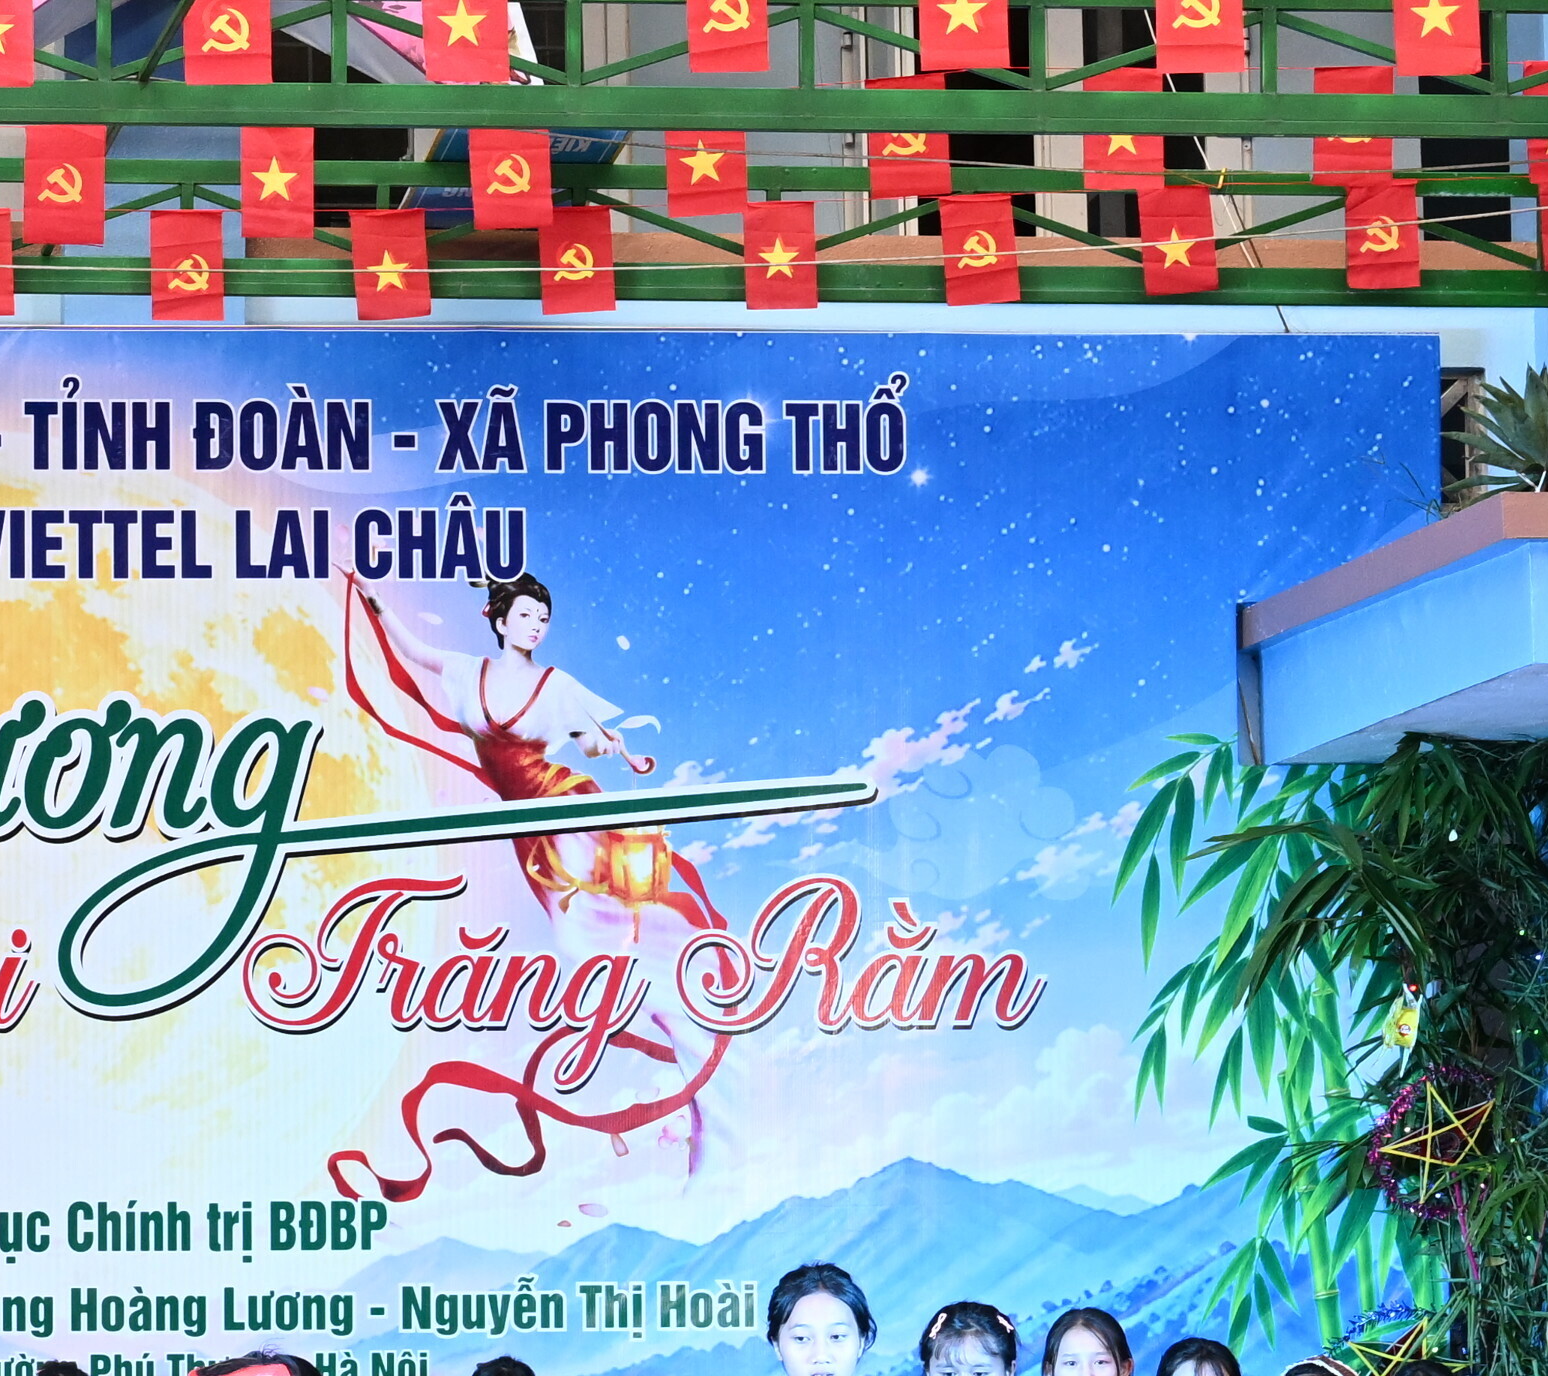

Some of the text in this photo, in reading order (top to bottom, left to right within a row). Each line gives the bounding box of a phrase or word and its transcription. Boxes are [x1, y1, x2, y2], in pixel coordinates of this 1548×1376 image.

[24, 376, 179, 471] TỈNH
[194, 384, 372, 471] ĐOÀN
[436, 388, 526, 473] XÃ
[545, 400, 765, 473] PHONG
[786, 372, 909, 474] THỔ
[234, 508, 329, 580] LAI
[354, 496, 526, 581] CHÂU
[245, 872, 650, 1092] Trăng
[677, 873, 1045, 1035] Rằm
[67, 1199, 196, 1252] Chính
[208, 1201, 255, 1264] trị
[270, 1201, 388, 1251] BĐBP
[69, 1281, 208, 1338] Hoàng
[223, 1286, 356, 1337] Lương
[401, 1274, 565, 1337] Nguyễn
[579, 1283, 646, 1341] Thị
[659, 1279, 757, 1331] Hoài
